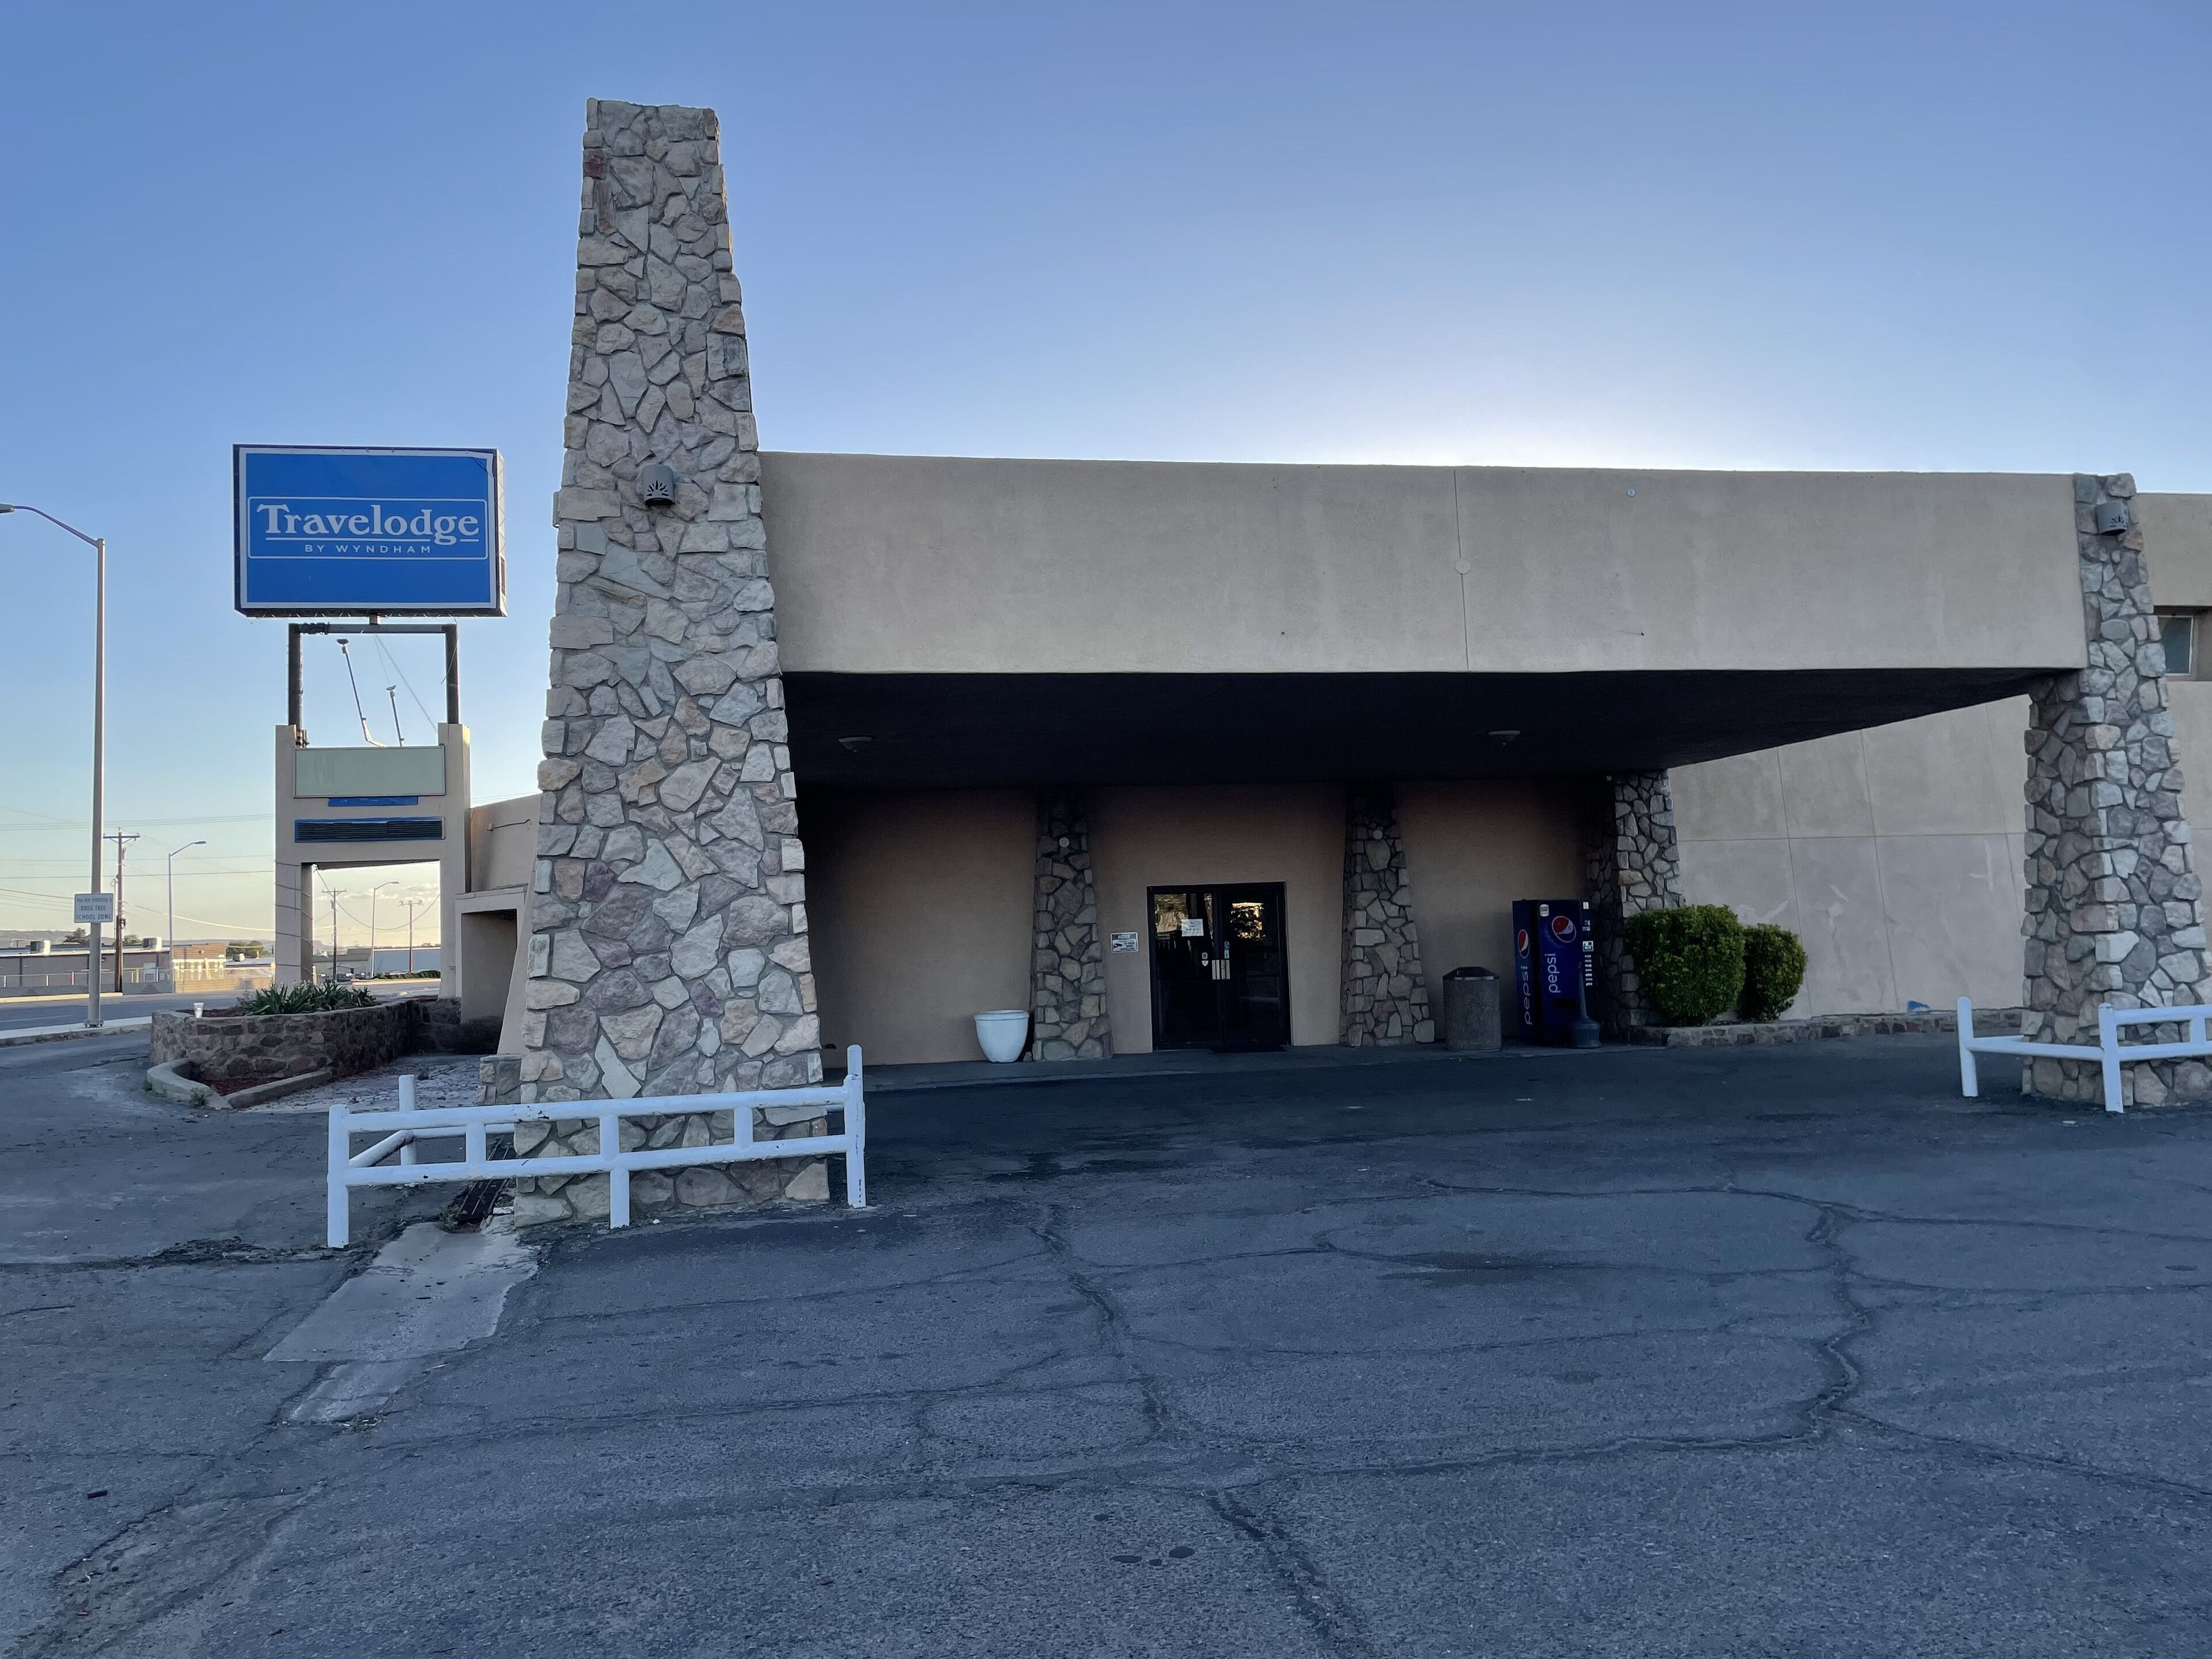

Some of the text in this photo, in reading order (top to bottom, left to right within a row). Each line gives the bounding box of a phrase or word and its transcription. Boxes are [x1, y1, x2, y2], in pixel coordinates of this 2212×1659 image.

[256, 503, 479, 546] Travelodge
[305, 544, 431, 554] BY WYNDHAM
[1544, 953, 1561, 993] pepsi
[1520, 966, 1532, 1025] pepsi
